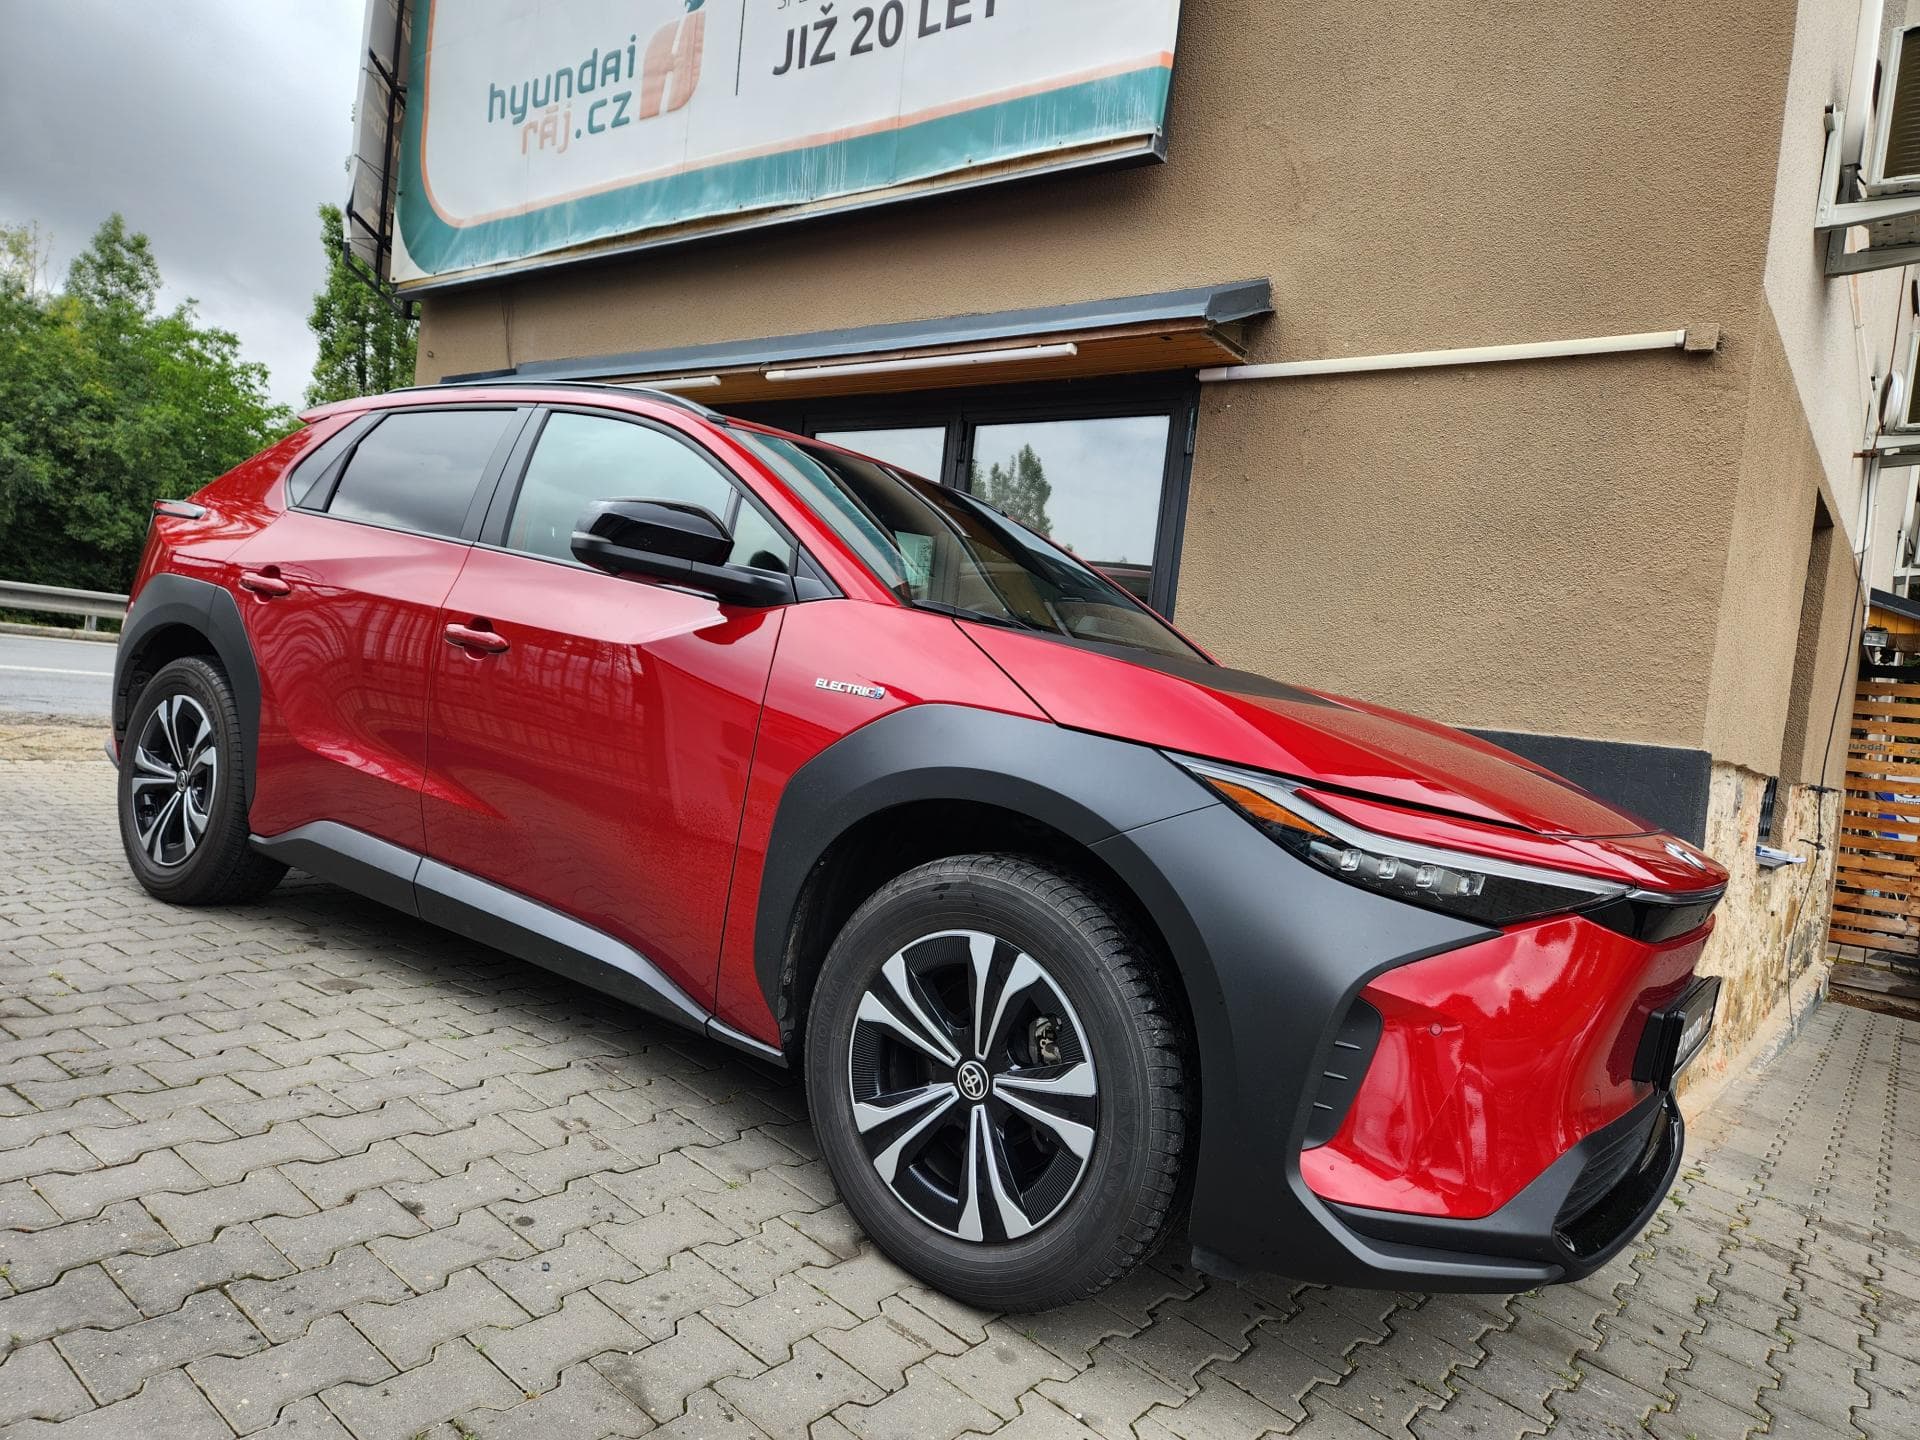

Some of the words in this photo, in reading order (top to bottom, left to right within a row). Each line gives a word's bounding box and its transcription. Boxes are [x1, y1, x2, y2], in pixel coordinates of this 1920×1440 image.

[772, 2, 838, 76] JIŽ
[850, 0, 905, 56] 20
[815, 678, 878, 698] ELECTRIC
